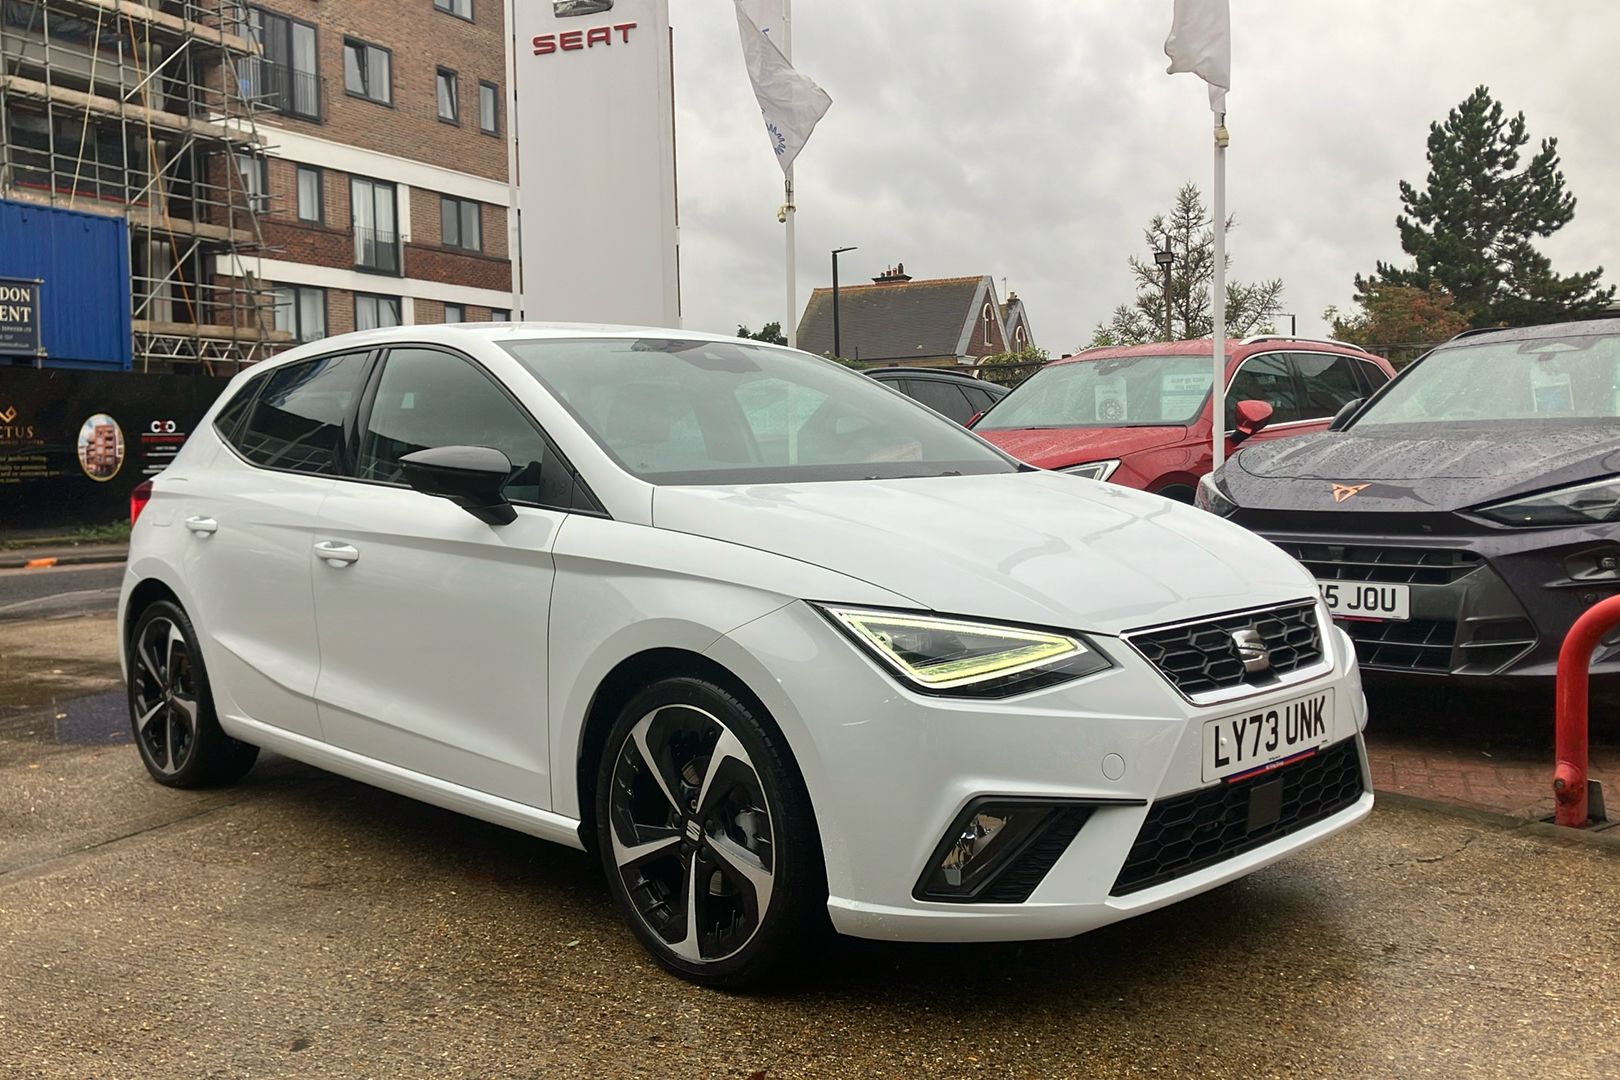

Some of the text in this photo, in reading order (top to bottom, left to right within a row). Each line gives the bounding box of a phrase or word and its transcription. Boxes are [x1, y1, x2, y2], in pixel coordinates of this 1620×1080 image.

[532, 22, 637, 55] SEAT
[1318, 584, 1396, 612] 5 JOU
[1214, 695, 1326, 769] LY73 UNK
